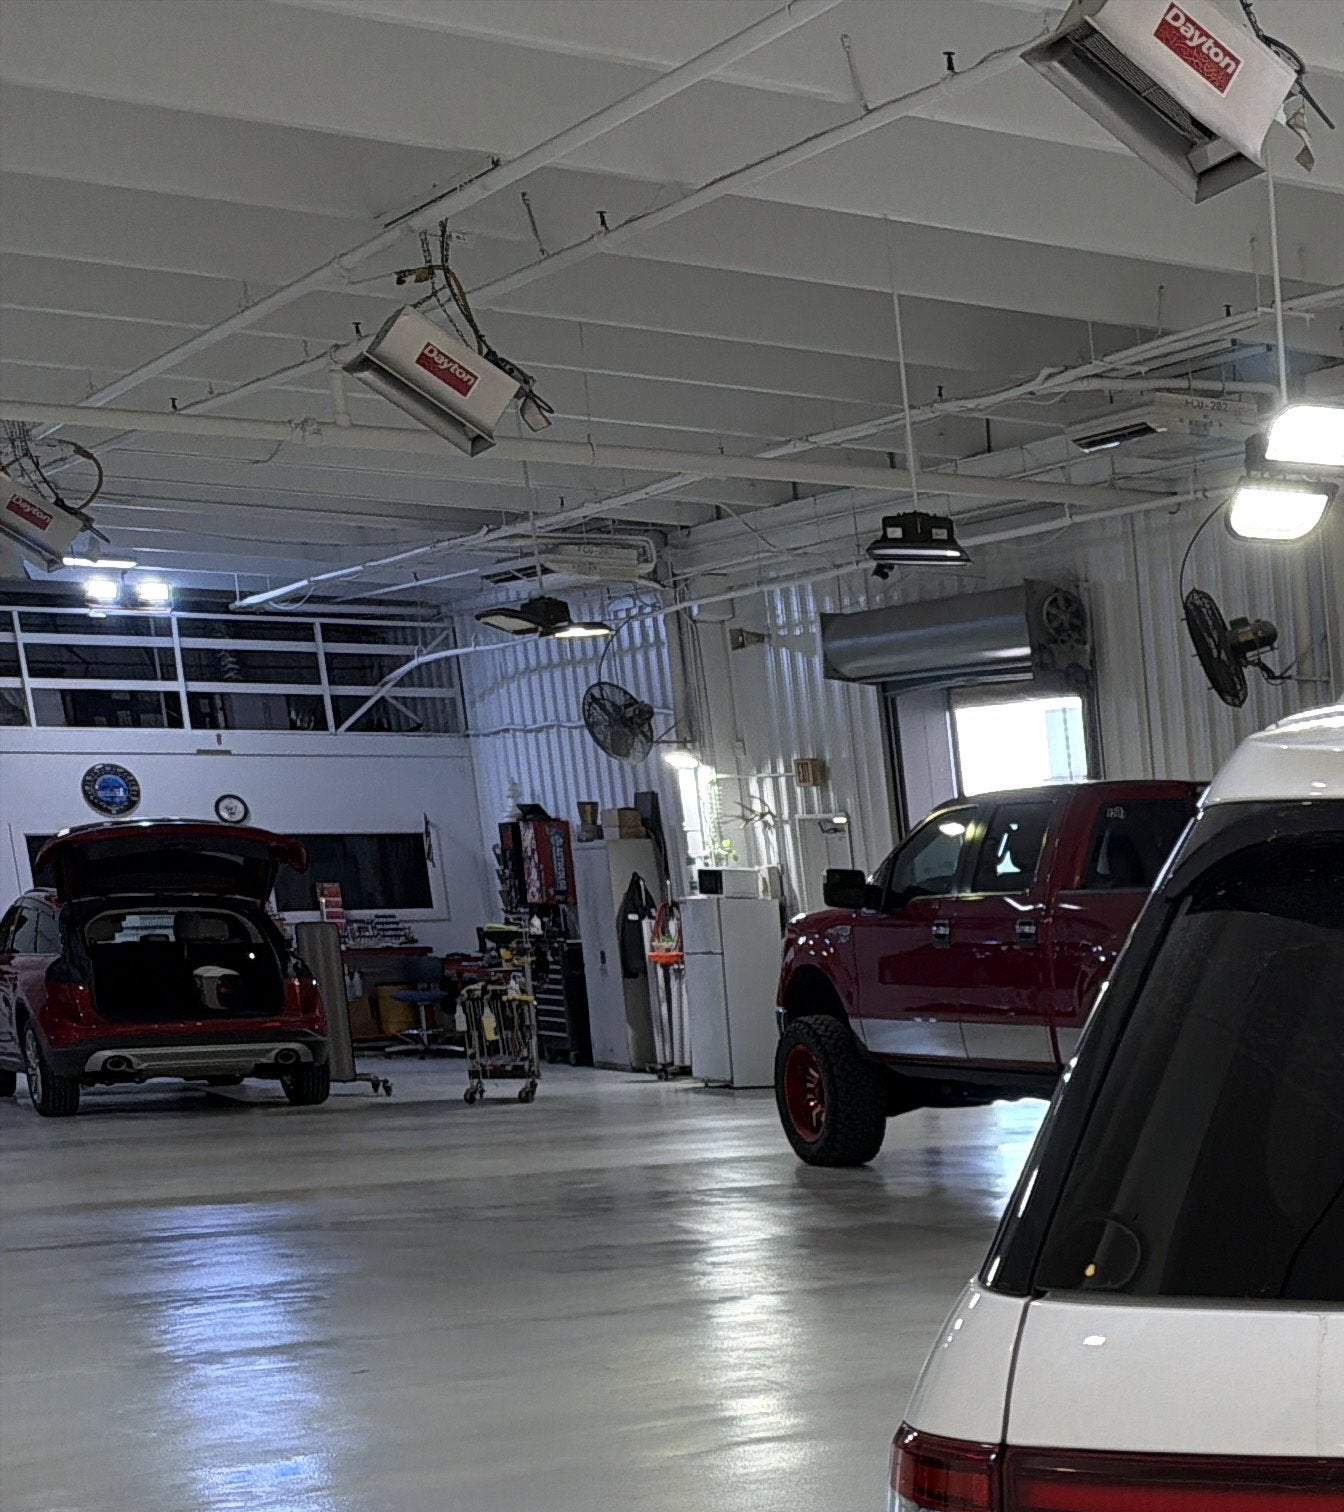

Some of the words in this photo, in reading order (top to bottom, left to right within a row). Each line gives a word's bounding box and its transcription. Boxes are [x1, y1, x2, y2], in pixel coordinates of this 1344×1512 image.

[1163, 5, 1238, 75] Dayton
[423, 344, 475, 385] Dayton
[12, 495, 52, 523] Dayton
